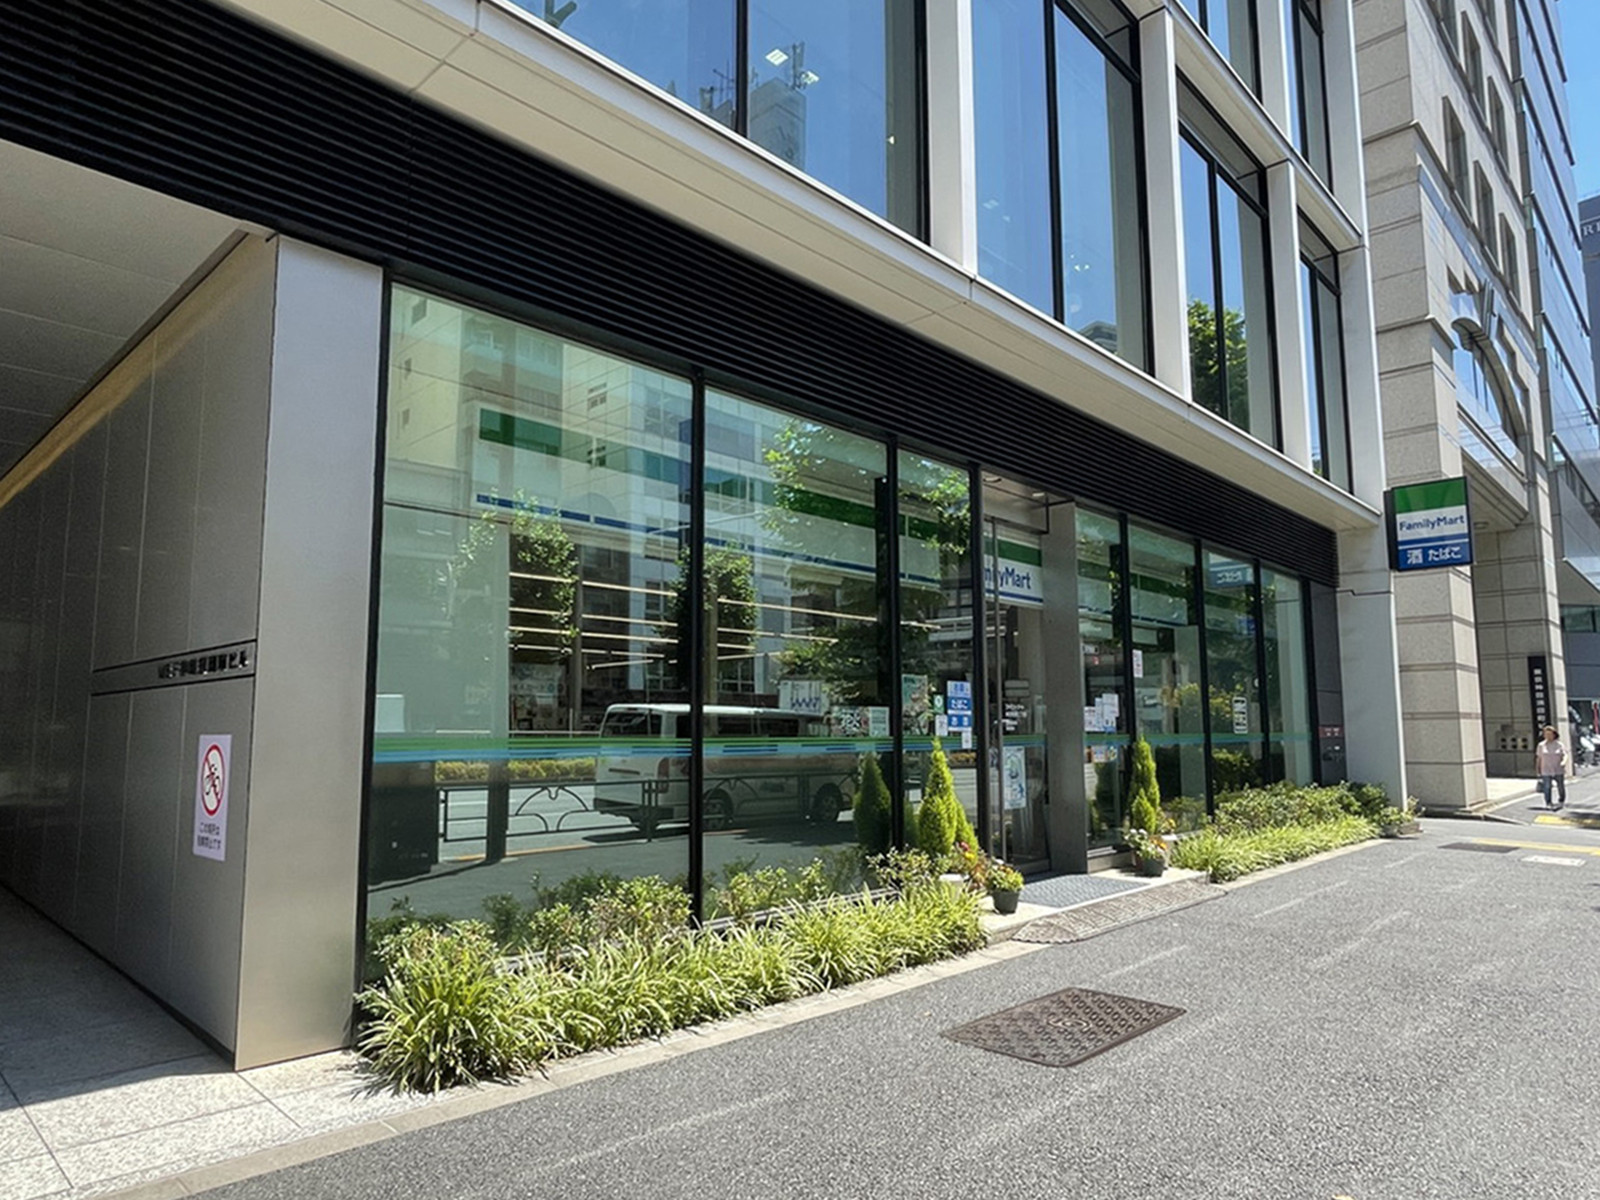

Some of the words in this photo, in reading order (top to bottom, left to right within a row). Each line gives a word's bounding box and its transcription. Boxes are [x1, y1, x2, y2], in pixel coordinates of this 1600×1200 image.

[1399, 515, 1465, 531] FamilyMart
[1406, 549, 1423, 564] 酒
[1428, 546, 1462, 561] たばこ
